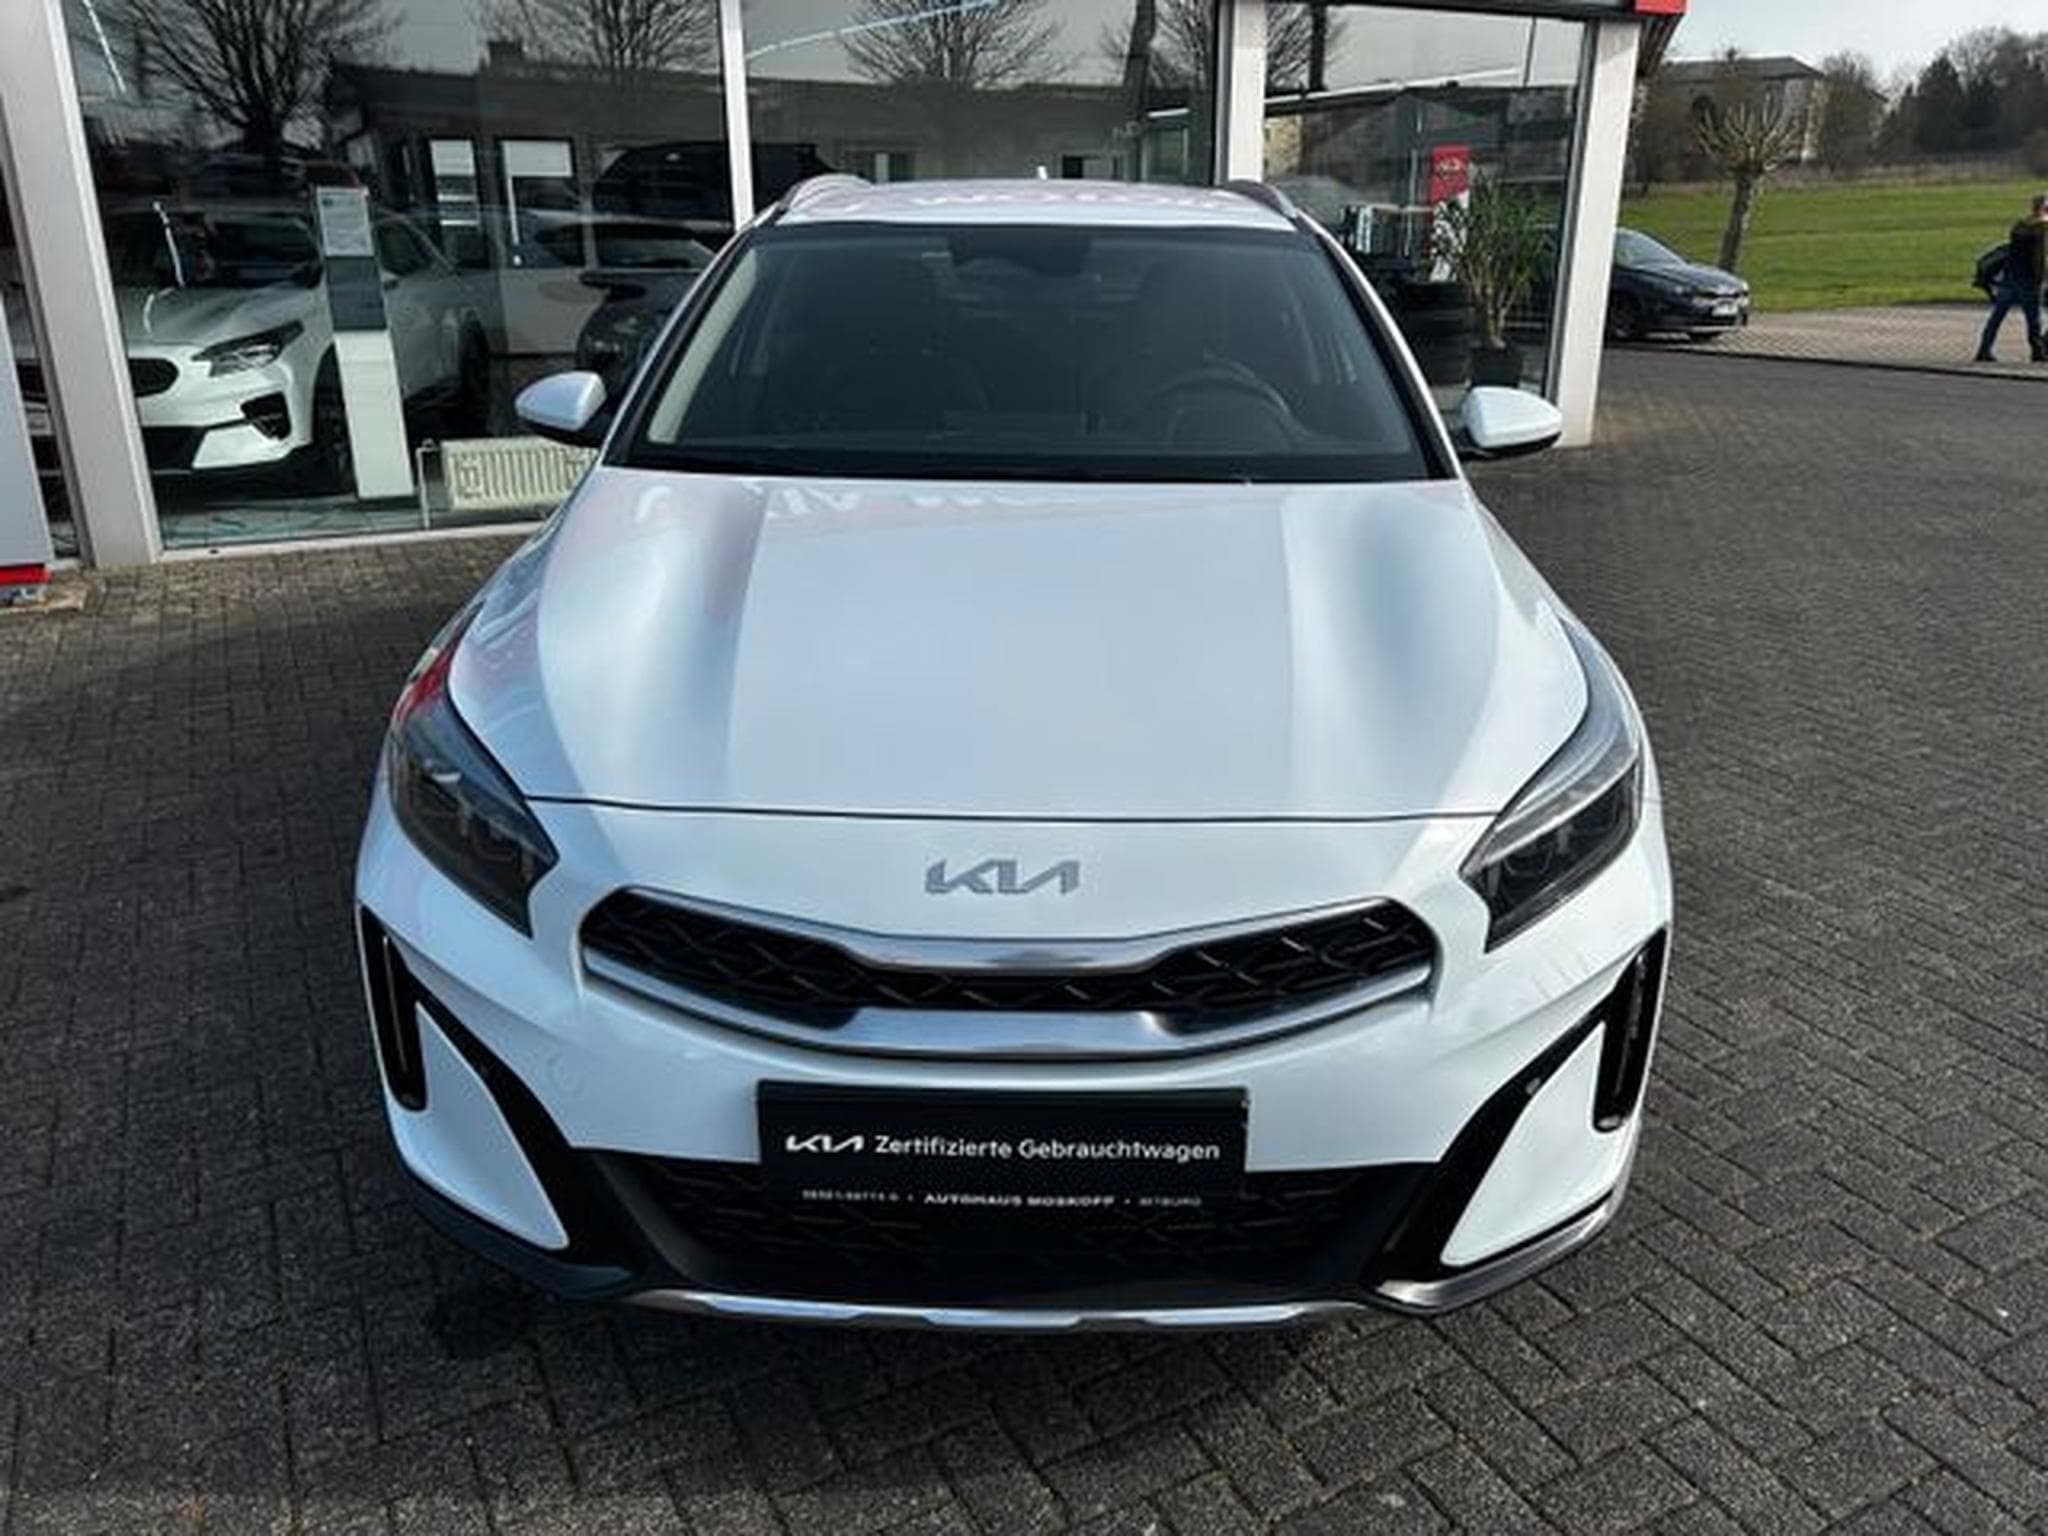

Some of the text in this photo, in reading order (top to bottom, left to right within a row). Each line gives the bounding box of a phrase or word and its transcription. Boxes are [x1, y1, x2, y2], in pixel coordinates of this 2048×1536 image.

[925, 859, 1080, 895] KIA
[786, 1134, 1220, 1164] KIA Zertifizierte Gebrauchtwagen
[923, 1193, 1022, 1207] AUTOHAUS
